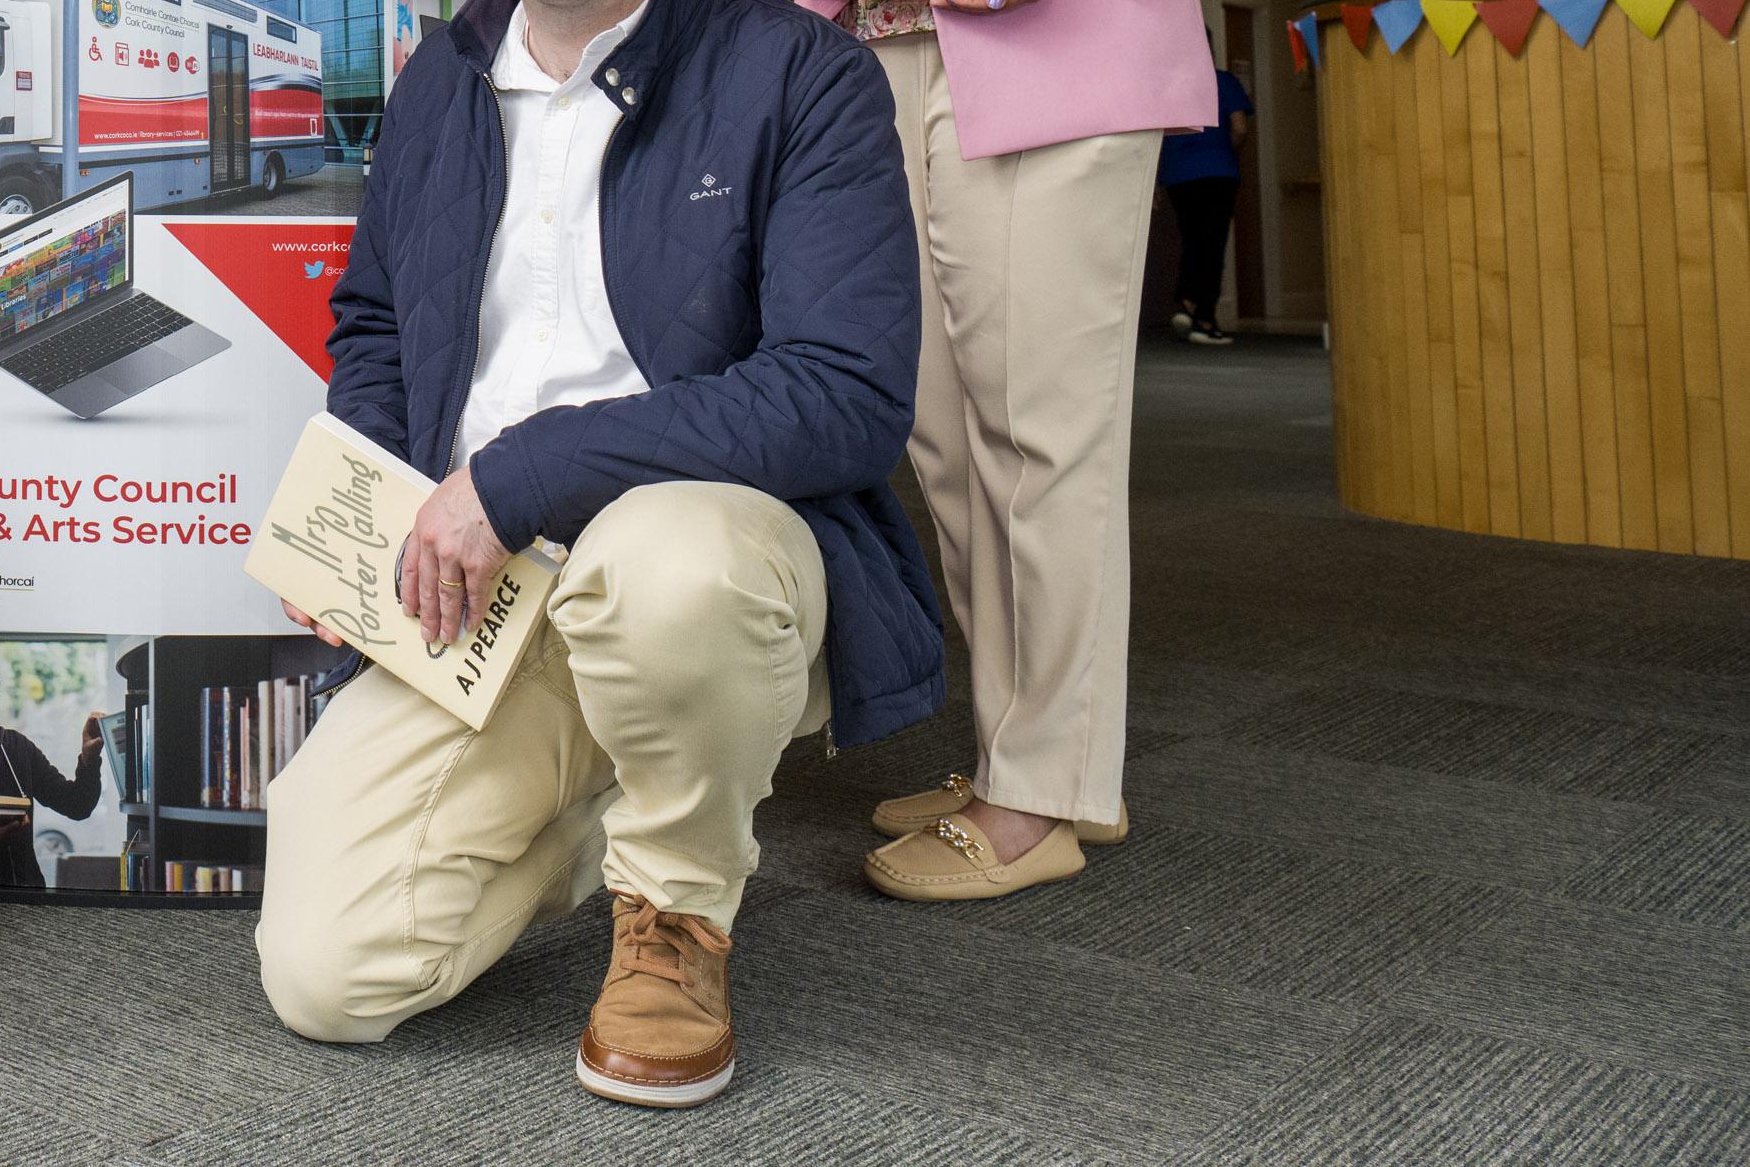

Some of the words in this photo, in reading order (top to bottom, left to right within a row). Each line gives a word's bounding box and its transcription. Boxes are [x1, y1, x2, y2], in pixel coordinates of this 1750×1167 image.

[125, 16, 140, 27] Cork
[142, 21, 164, 34] County
[165, 26, 185, 37] Council
[253, 43, 299, 66] LEABHARLANN
[690, 187, 732, 201] GANT
[325, 266, 344, 276] @co
[1, 294, 27, 310] Libraries
[93, 473, 237, 504] Council
[314, 453, 390, 549] Calling
[23, 513, 101, 543] Arts
[112, 515, 252, 545] Service
[271, 515, 343, 574] Mrs
[318, 553, 397, 649] Porter
[469, 573, 522, 663] PEARCE
[465, 657, 482, 680] J
[456, 674, 475, 696] A
